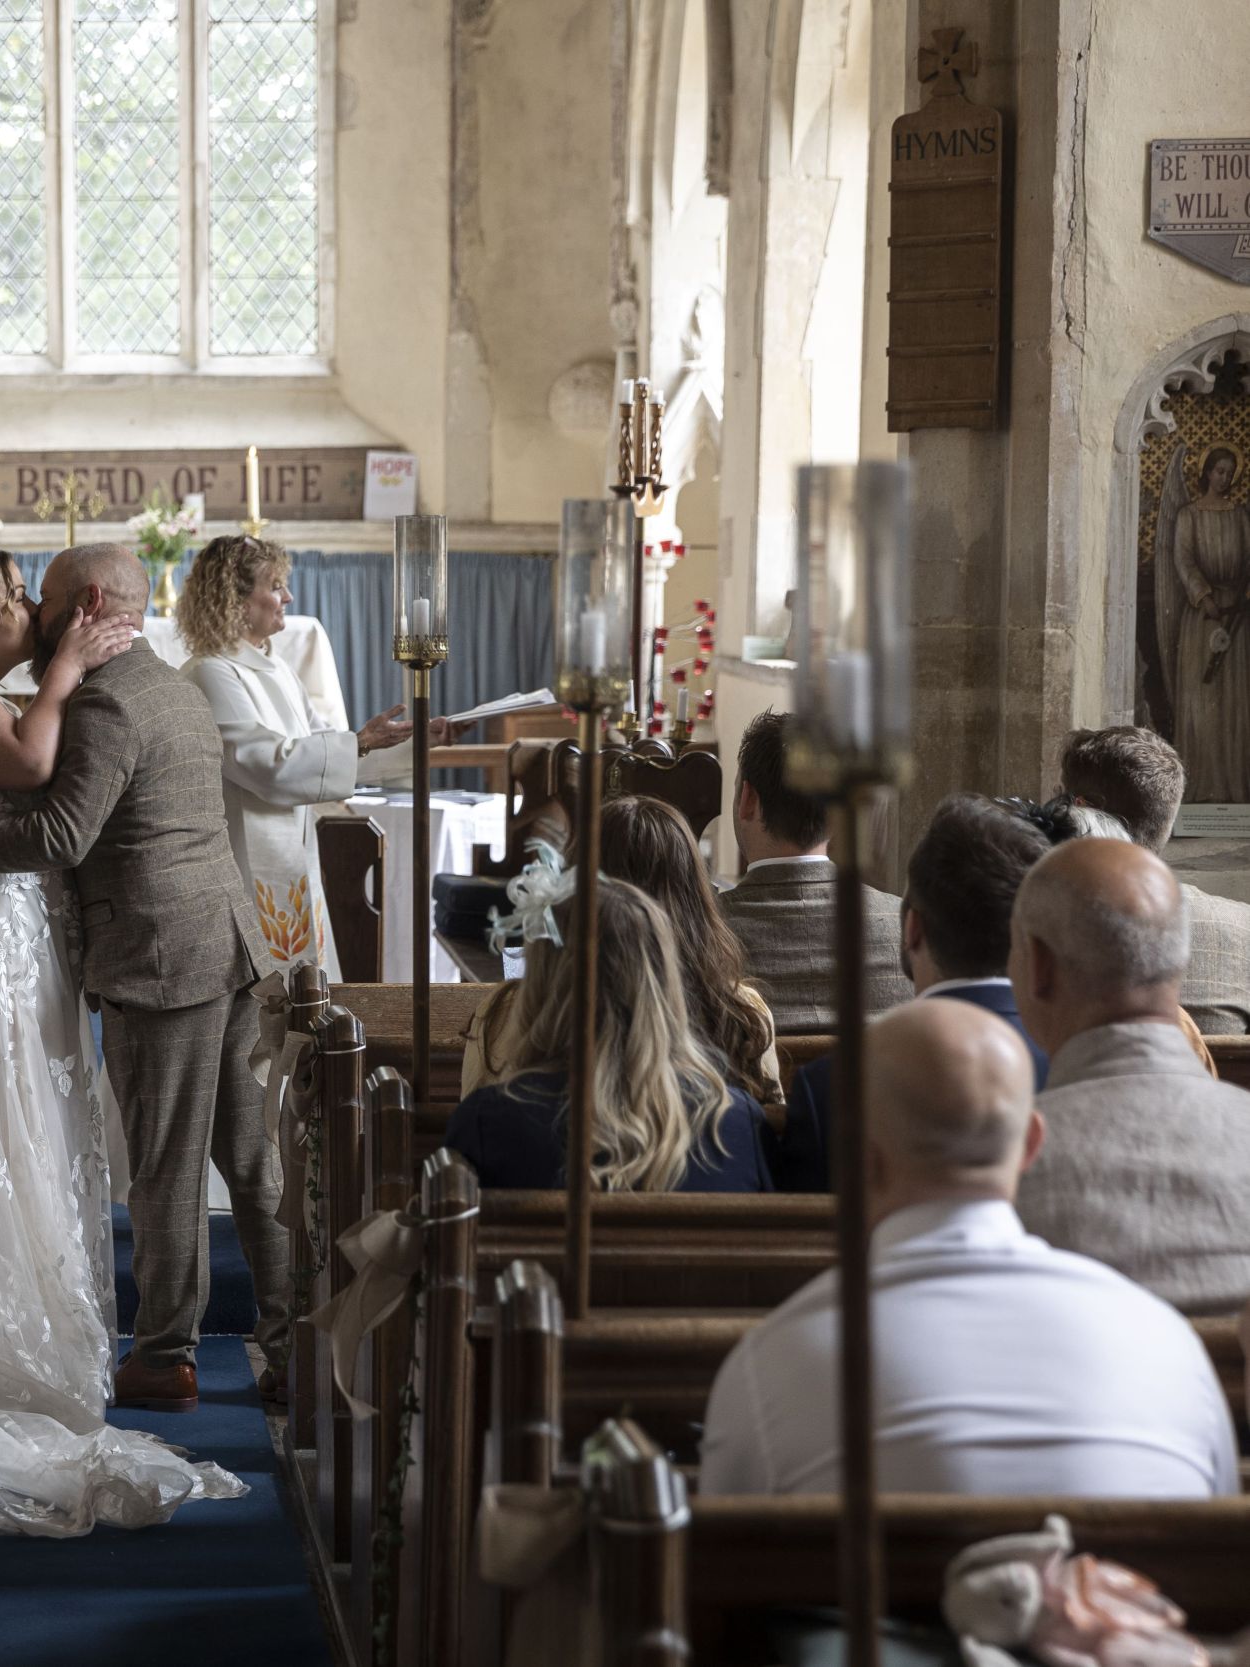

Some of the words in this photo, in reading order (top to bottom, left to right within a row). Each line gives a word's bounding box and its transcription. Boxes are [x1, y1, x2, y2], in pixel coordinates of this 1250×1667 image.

[894, 127, 997, 161] HYMNS
[1160, 154, 1187, 181] BE
[1175, 192, 1229, 219] WILL
[370, 459, 413, 476] HOPE
[171, 464, 217, 504] OF
